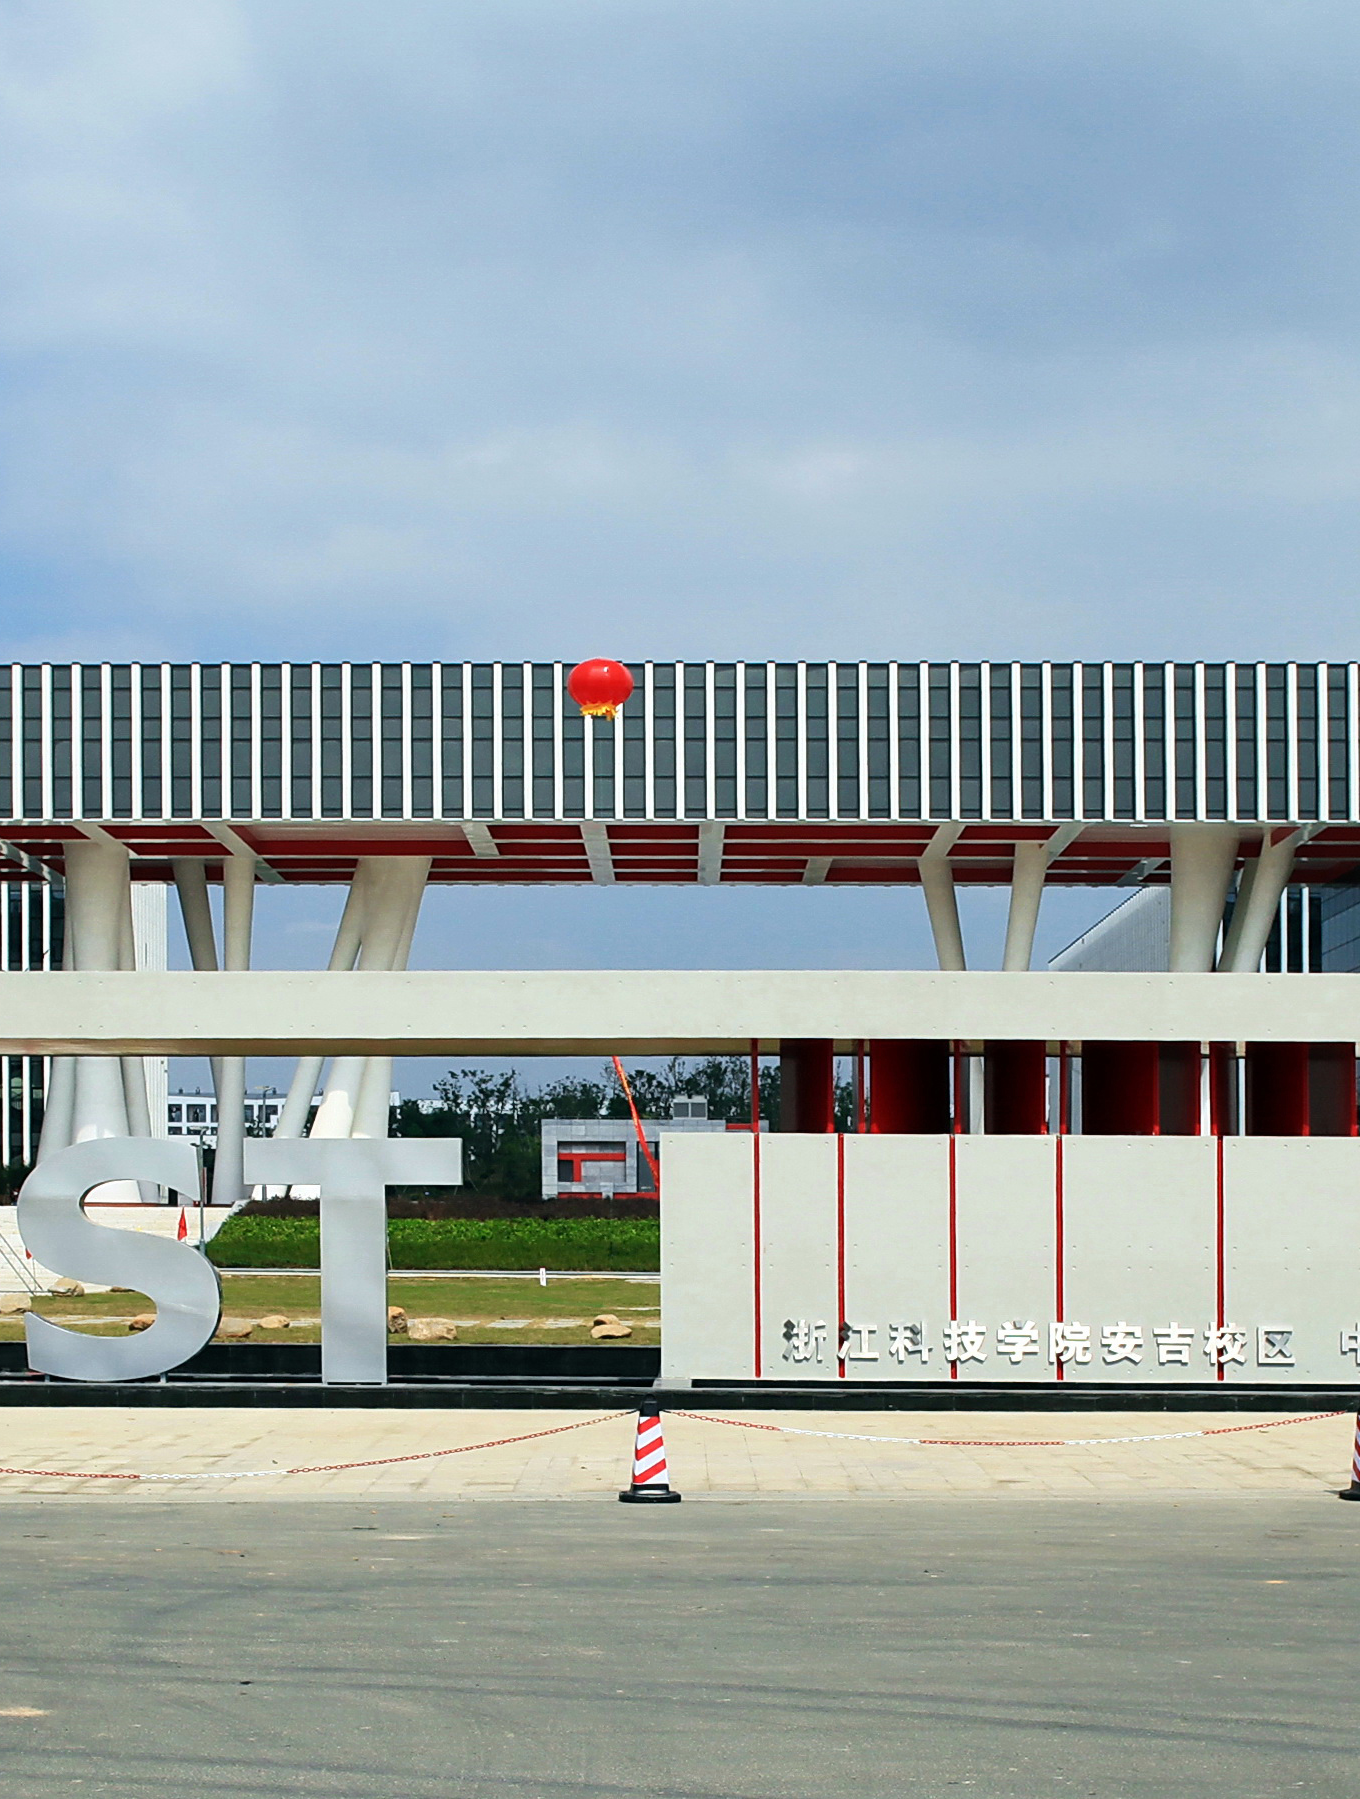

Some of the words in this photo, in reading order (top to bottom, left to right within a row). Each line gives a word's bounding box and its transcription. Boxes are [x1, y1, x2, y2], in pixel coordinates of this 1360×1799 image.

[783, 1318, 1296, 1367] 浙江科技学院安吉校区
